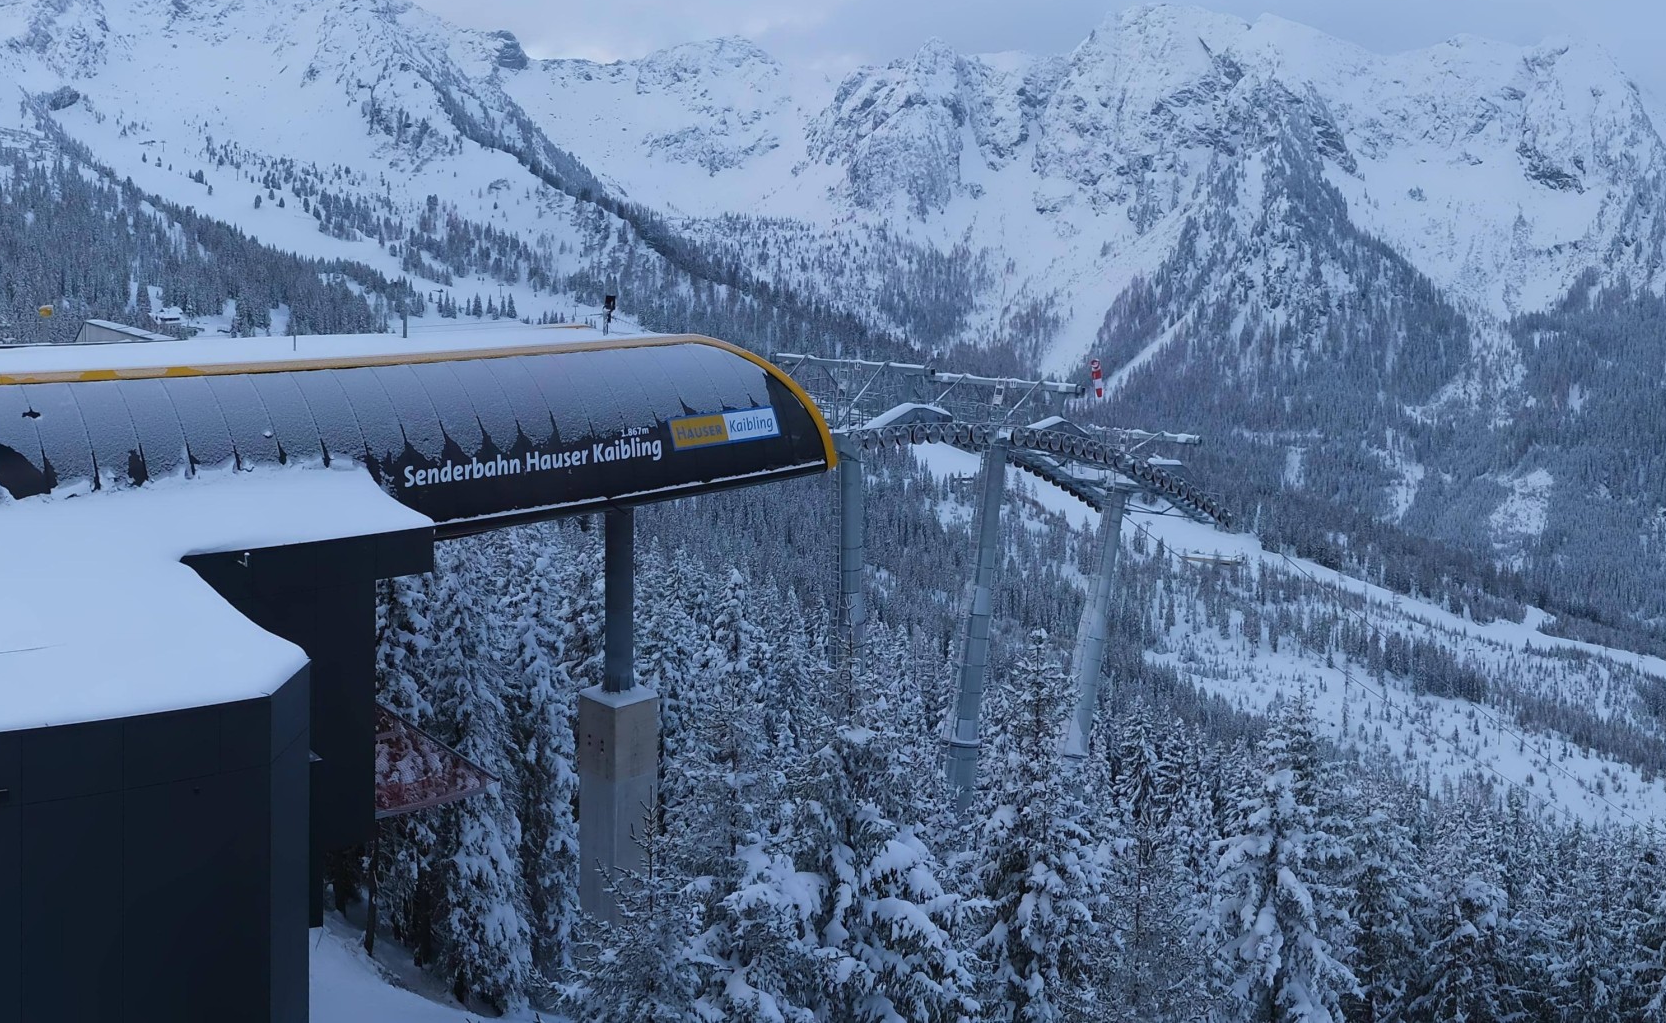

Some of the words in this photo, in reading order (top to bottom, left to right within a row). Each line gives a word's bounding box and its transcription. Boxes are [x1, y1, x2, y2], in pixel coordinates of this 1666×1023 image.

[621, 427, 649, 437] 1.867m
[676, 425, 722, 440] HAUSER
[729, 416, 773, 433] Kaibling
[403, 454, 521, 488] Senderbahn
[526, 449, 588, 472] Hauser
[593, 438, 662, 463] Kaibling
